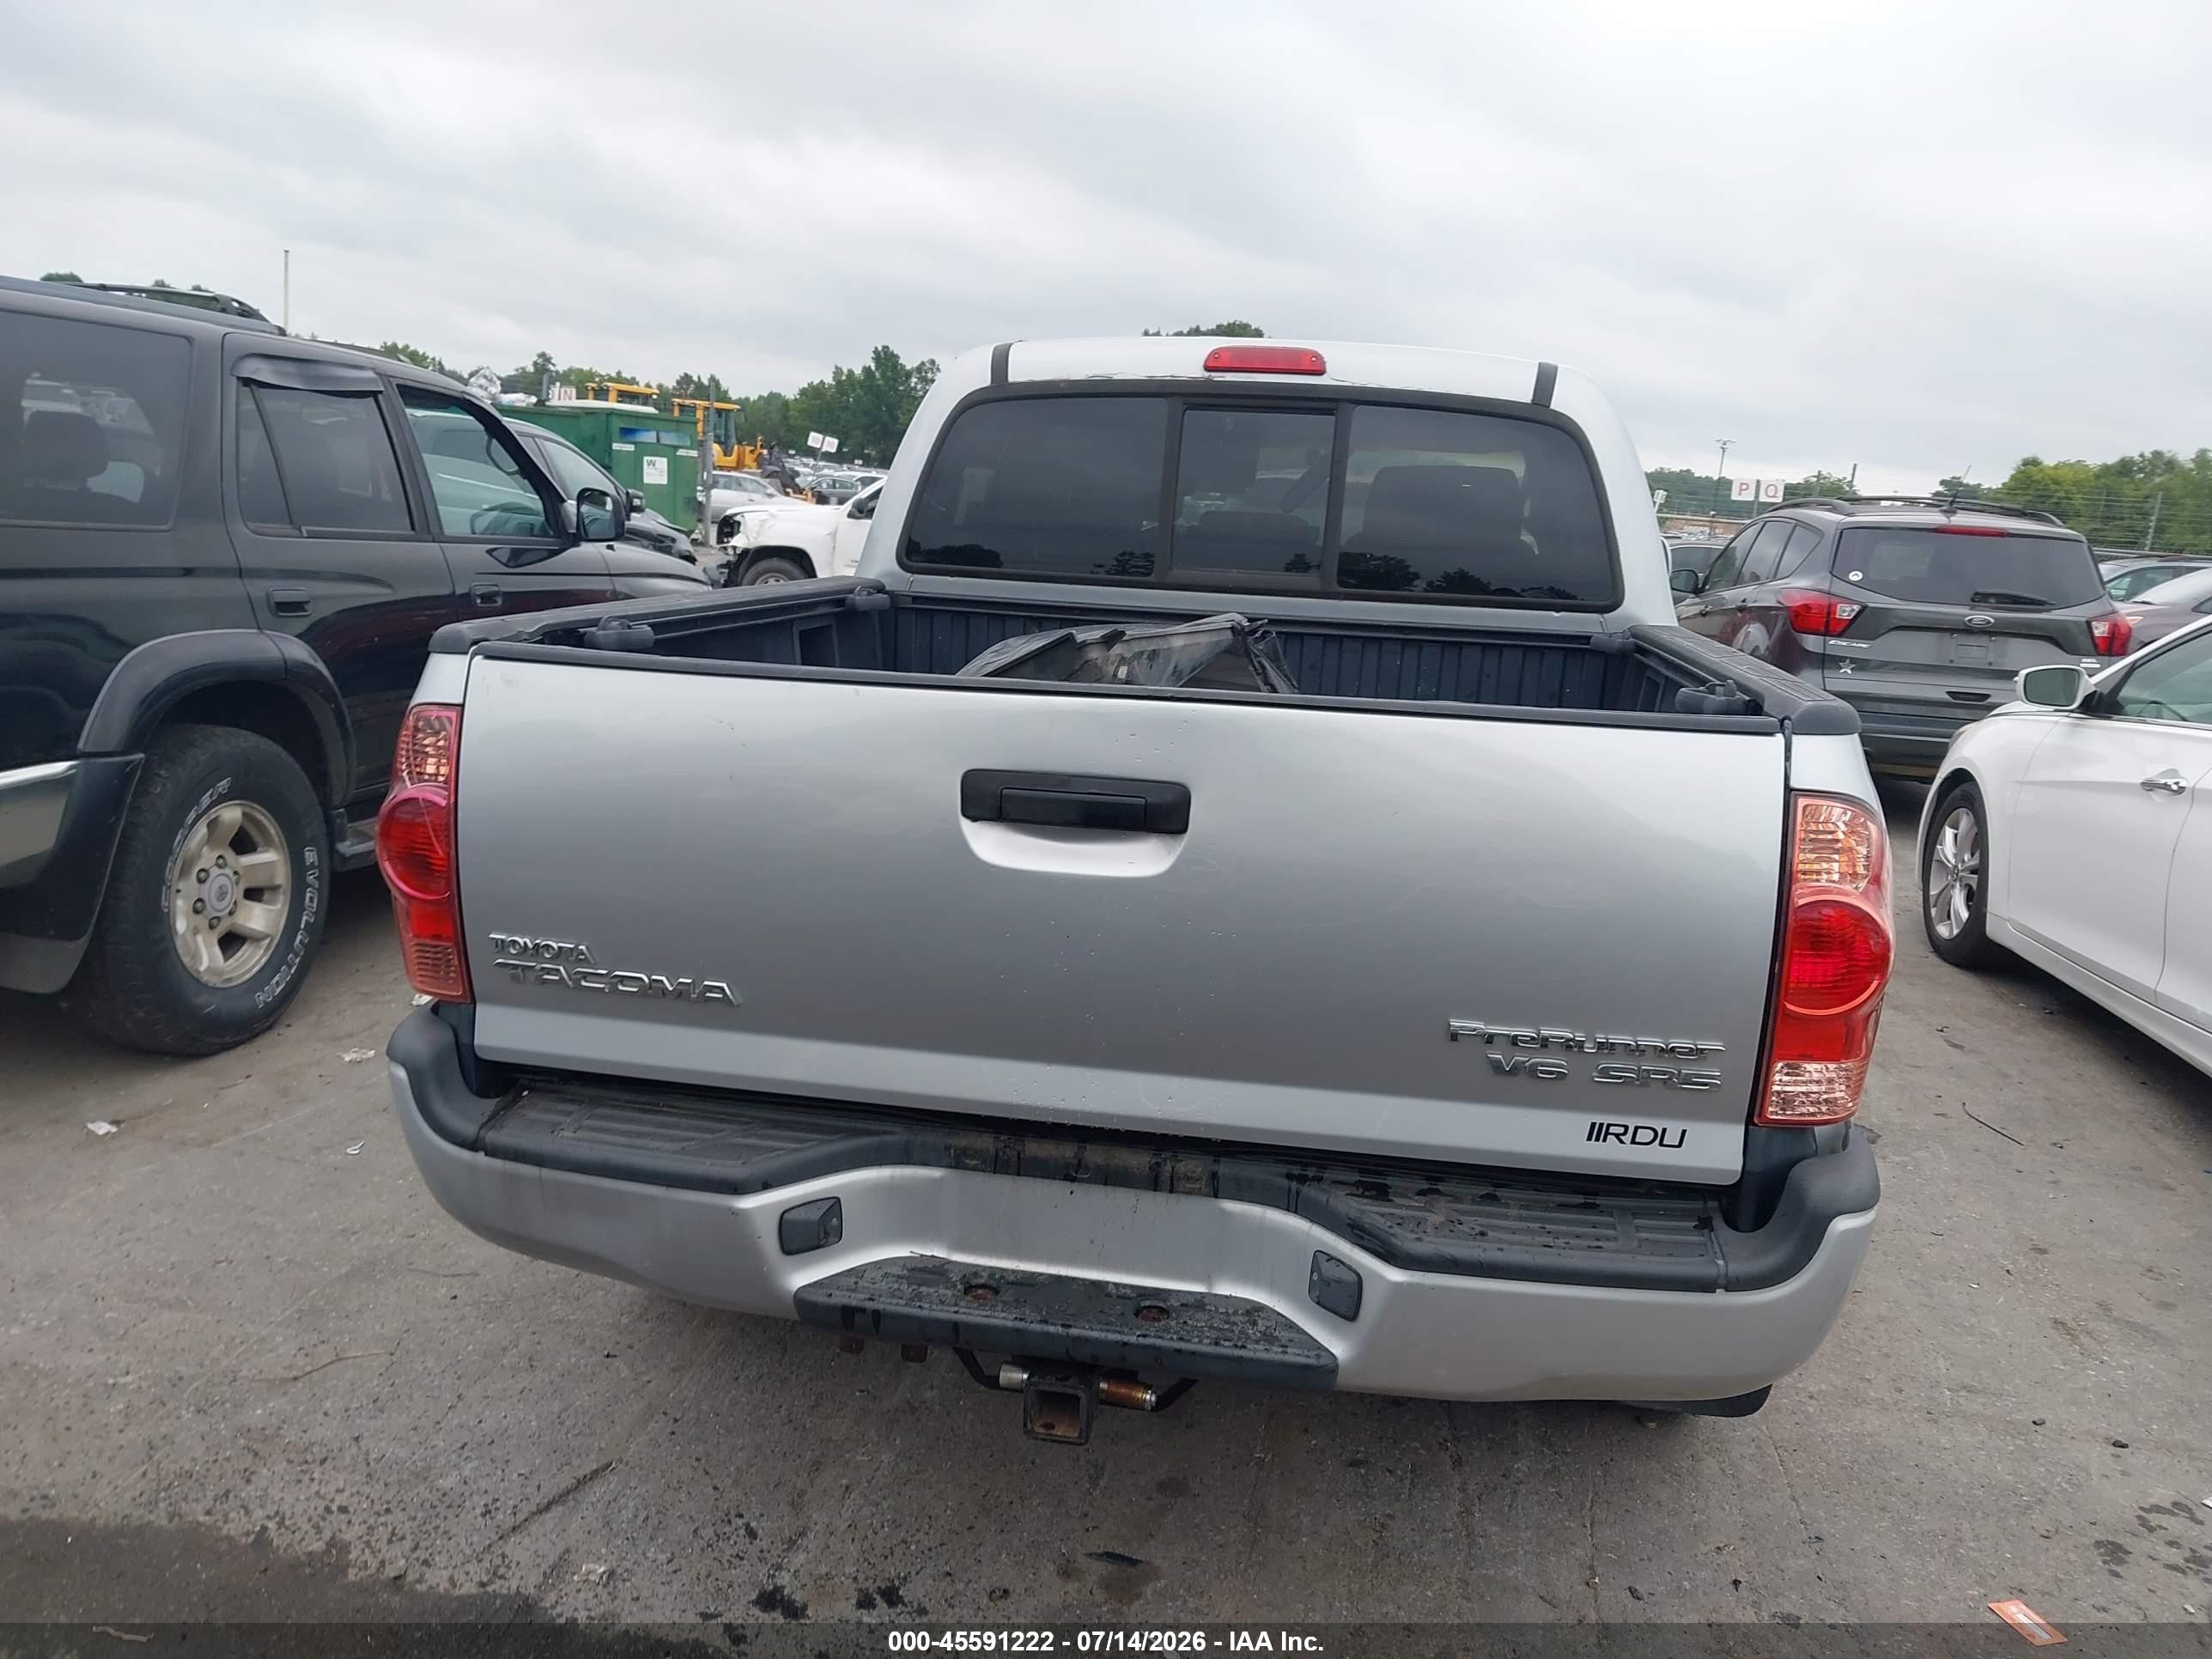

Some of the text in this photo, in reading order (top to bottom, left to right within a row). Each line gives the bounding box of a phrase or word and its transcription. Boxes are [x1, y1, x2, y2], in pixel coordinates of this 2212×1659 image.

[562, 389, 573, 399] N
[1738, 482, 1749, 495] P
[1765, 483, 1778, 498] Q
[255, 846, 319, 1009] EVOLUTION
[489, 933, 594, 964] TOYOTA
[494, 957, 738, 1006] TACOMA
[1486, 1051, 1723, 1091] V6 SR5
